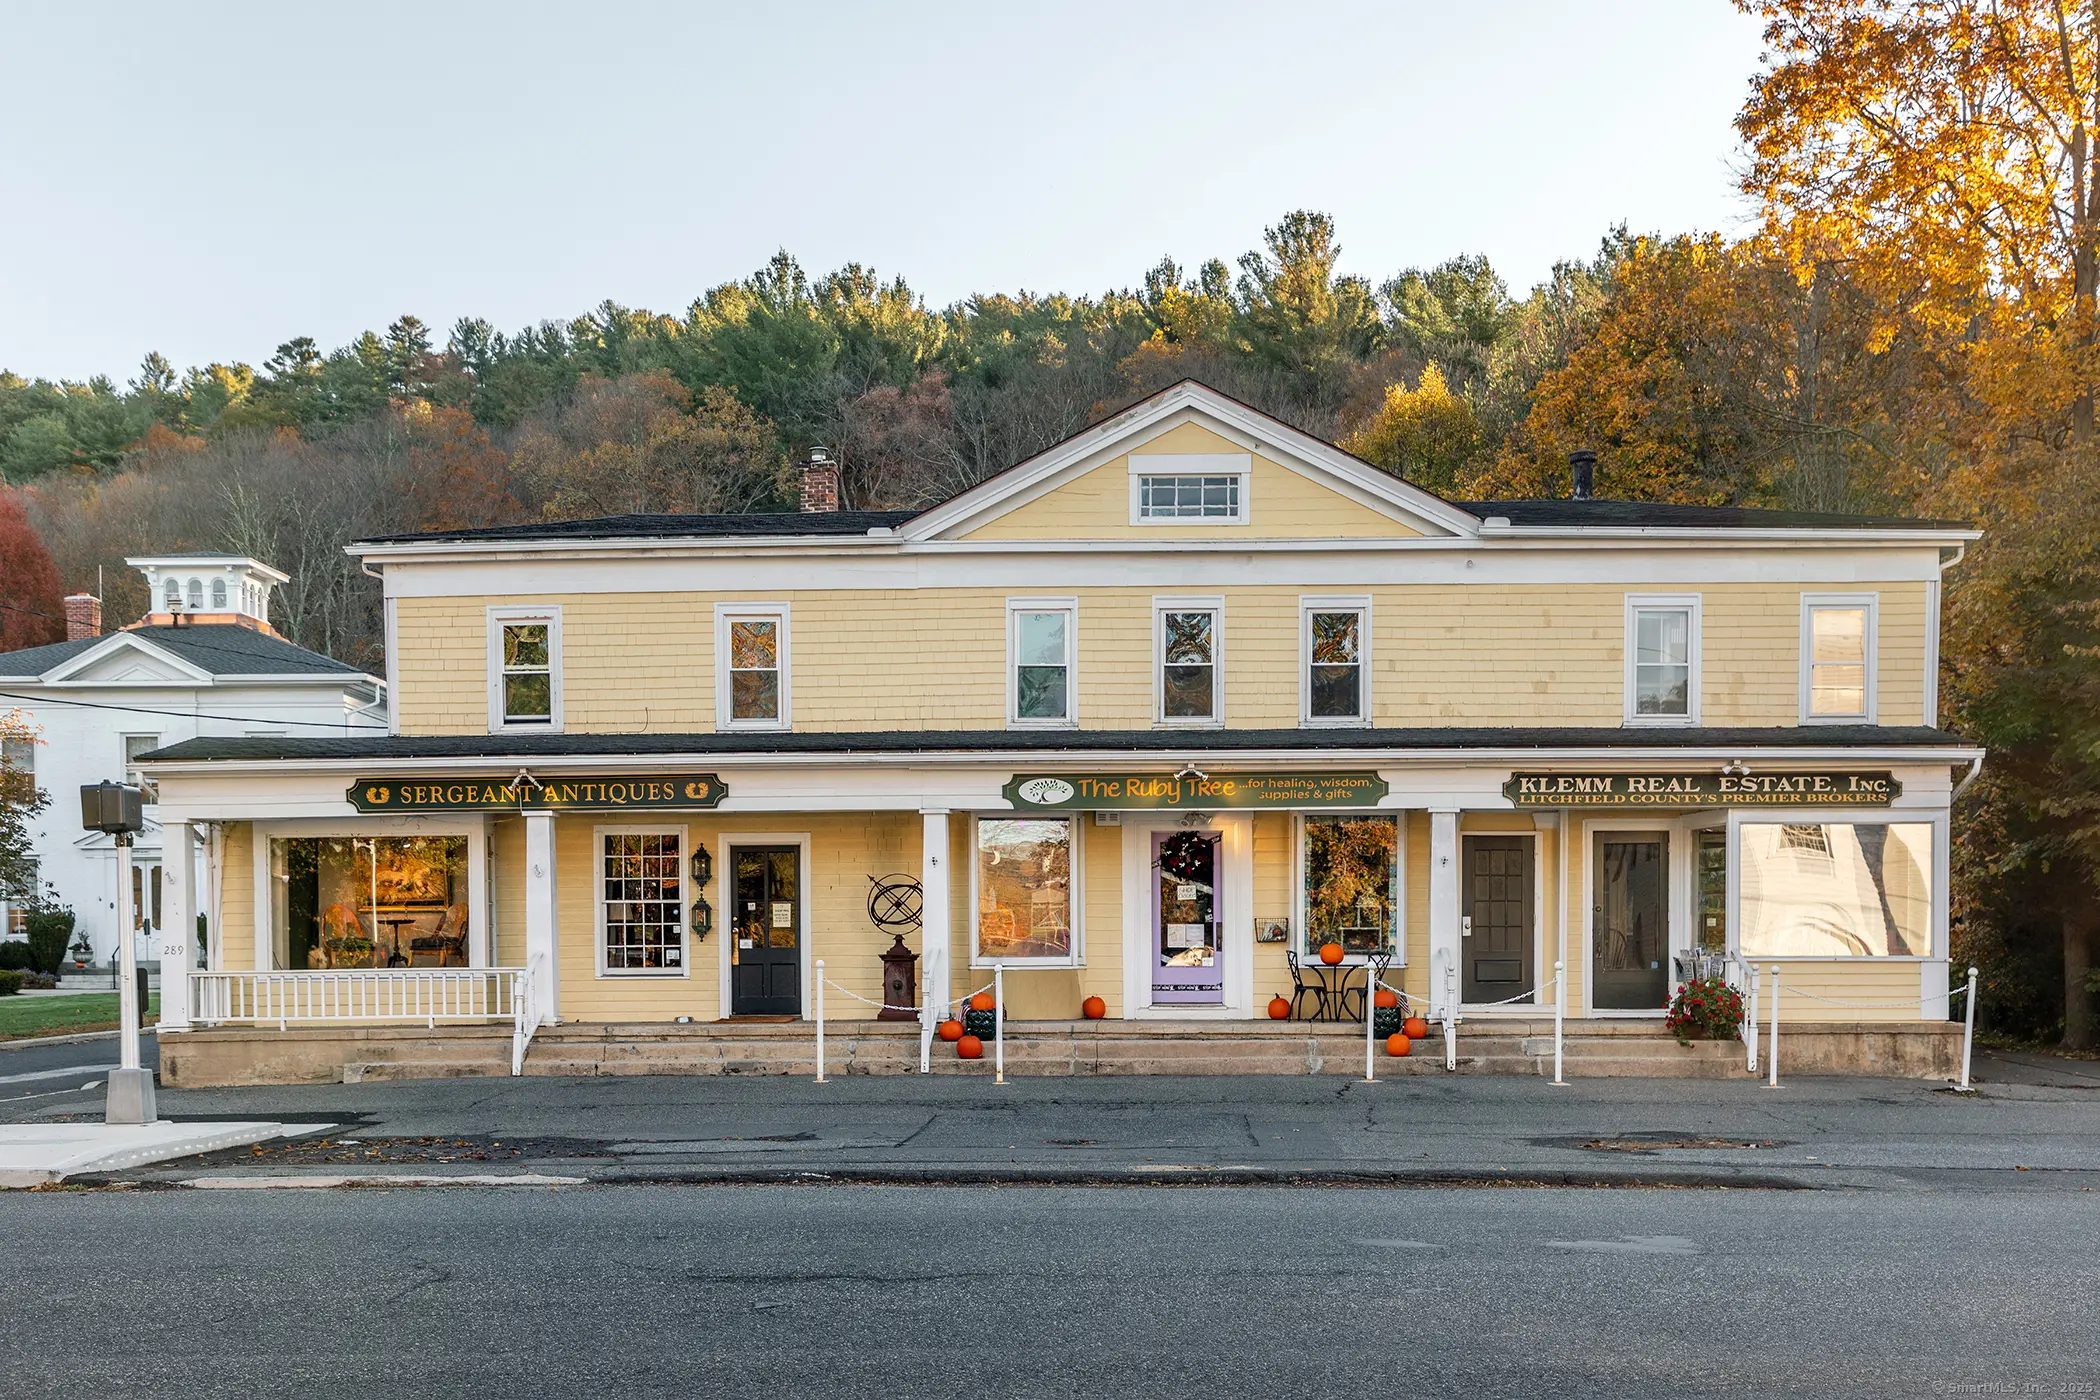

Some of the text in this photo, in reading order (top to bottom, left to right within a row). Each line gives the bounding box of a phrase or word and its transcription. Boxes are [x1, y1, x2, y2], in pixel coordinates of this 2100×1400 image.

[1268, 778, 1317, 789] healing,
[1320, 777, 1373, 788] wisdom,
[1519, 777, 1613, 793] KLEMM
[1627, 777, 1701, 793] REAL
[1718, 776, 1837, 794] ESTATE,
[400, 782, 675, 804] SERGEANT ANTIQUES
[1077, 778, 1121, 798] The
[1126, 778, 1181, 804] Ruby
[1259, 788, 1353, 800] supplies & gifts
[1520, 792, 1888, 804] LITCHFIELD COUNTY'S PREMIER BROKERS
[164, 945, 184, 955] 289
